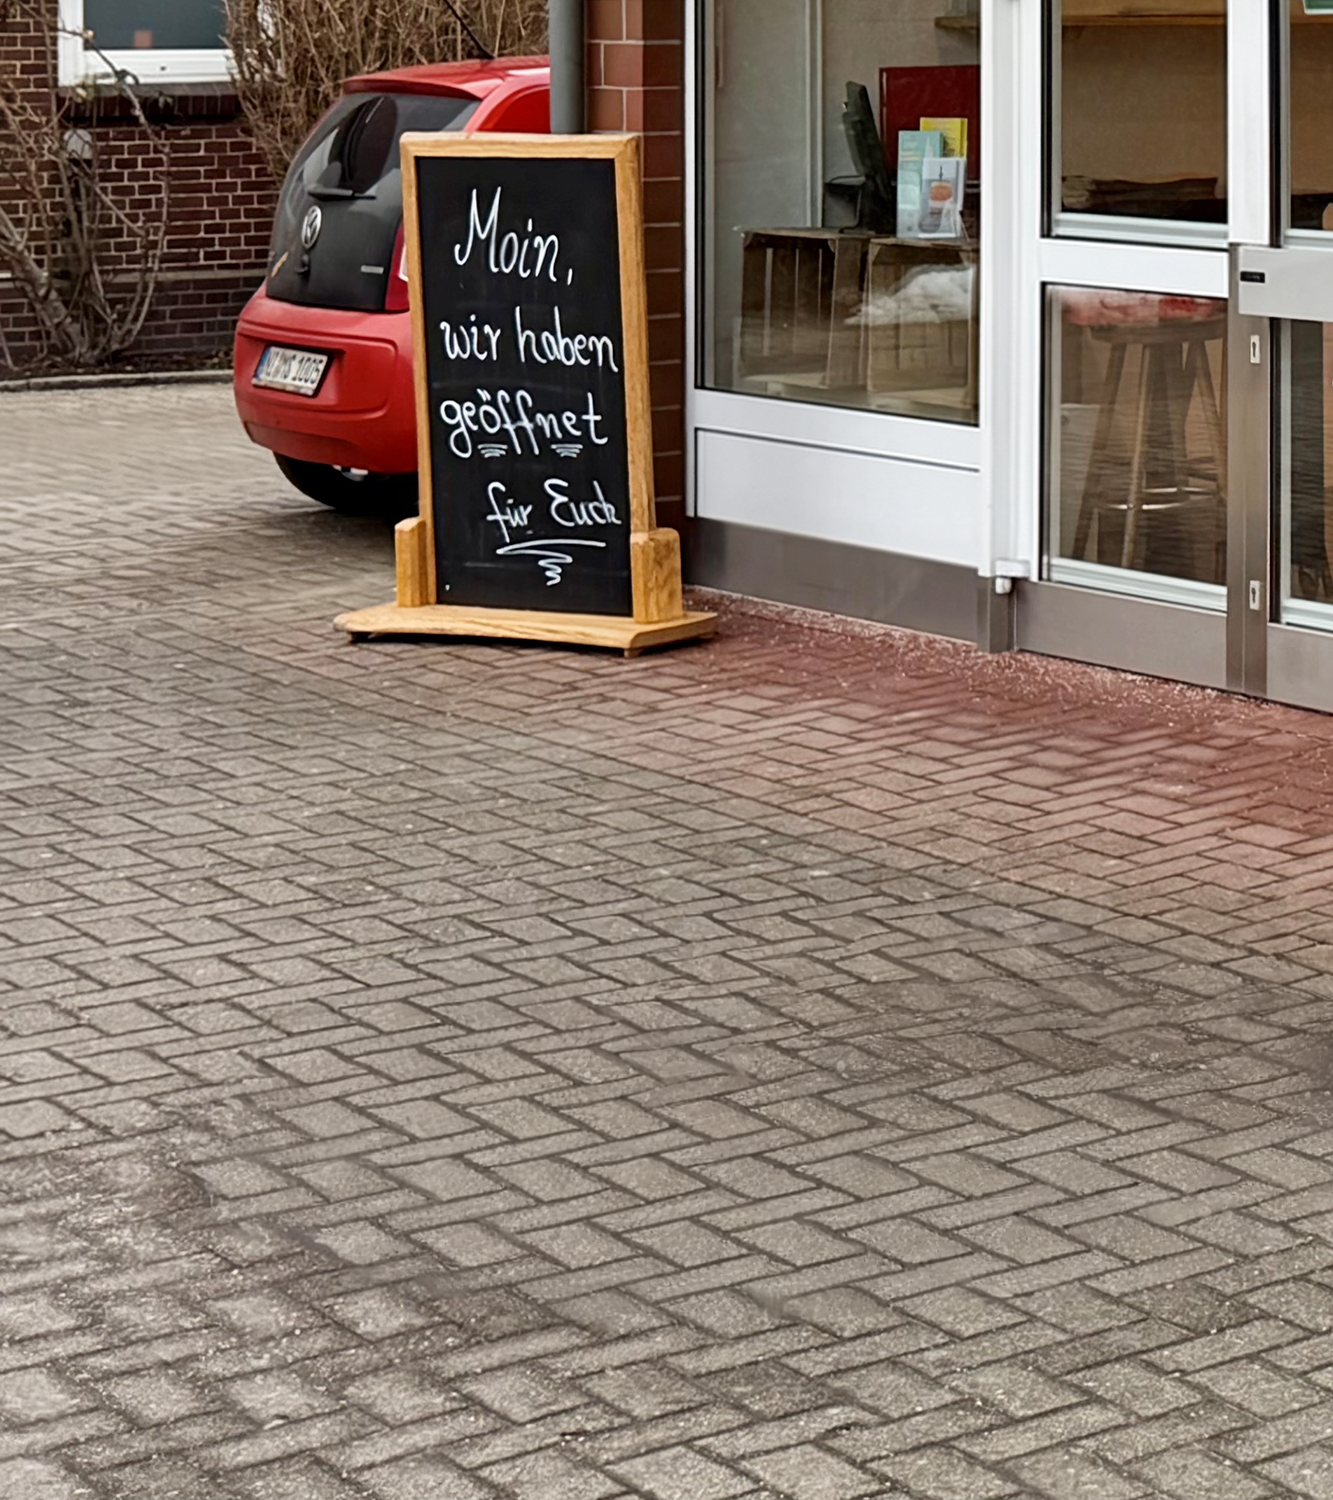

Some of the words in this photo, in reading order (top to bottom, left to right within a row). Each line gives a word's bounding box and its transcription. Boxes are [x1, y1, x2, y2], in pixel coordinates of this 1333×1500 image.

[454, 186, 573, 286] Moin,
[440, 314, 501, 361] wir
[515, 305, 619, 373] haben
[440, 388, 608, 458] geöffnet
[486, 481, 533, 543] für
[544, 478, 622, 527] Euch
